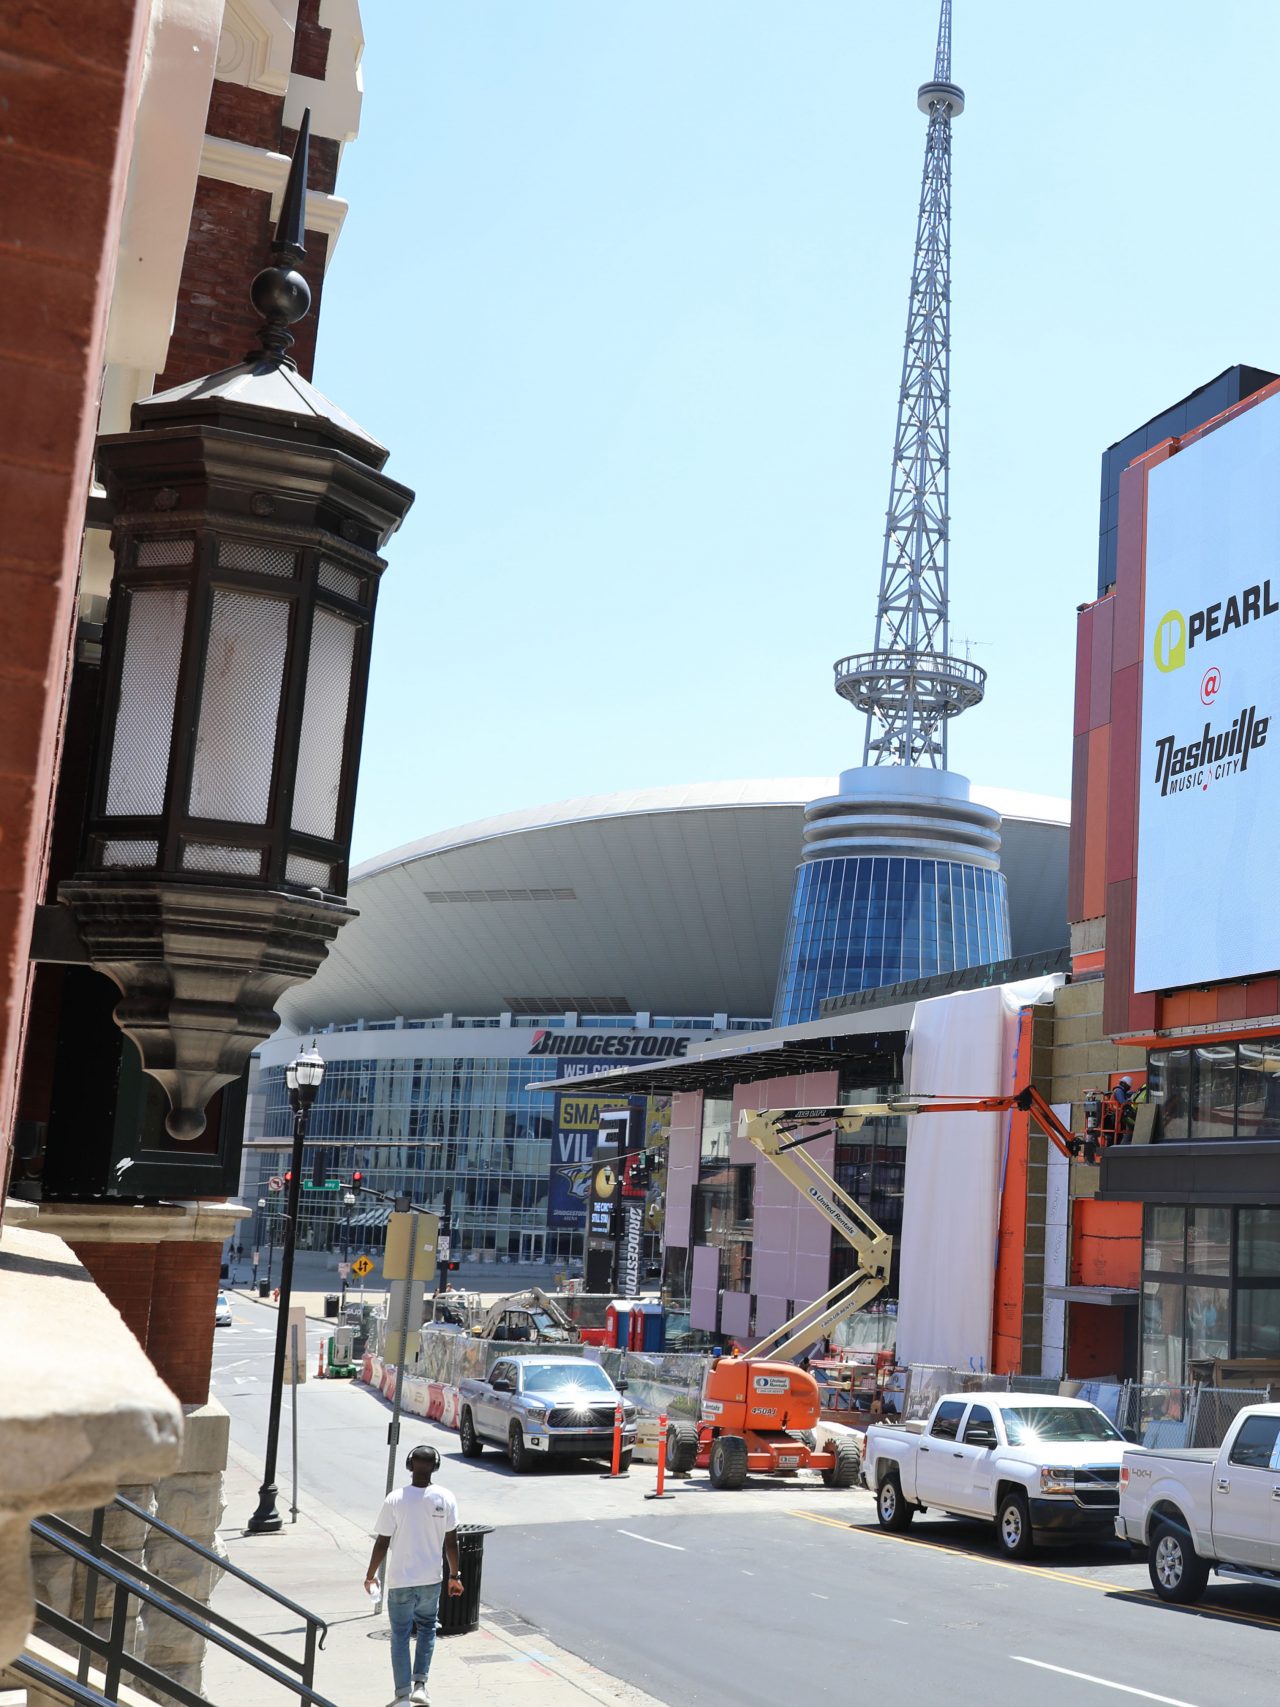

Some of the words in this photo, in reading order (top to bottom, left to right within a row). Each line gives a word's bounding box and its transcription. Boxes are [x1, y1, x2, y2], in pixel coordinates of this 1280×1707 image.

[1188, 579, 1279, 649] PEARL
[1154, 705, 1270, 797] Nashville
[1169, 770, 1204, 794] MUSIC
[1215, 759, 1240, 780] CITY
[528, 1030, 690, 1057] BRIDGESTONE
[563, 1103, 612, 1125] SMA
[558, 1133, 593, 1162] VIL
[816, 1194, 835, 1215] United
[834, 1212, 855, 1234] Rentals
[626, 1207, 642, 1296] BRIDGESTON
